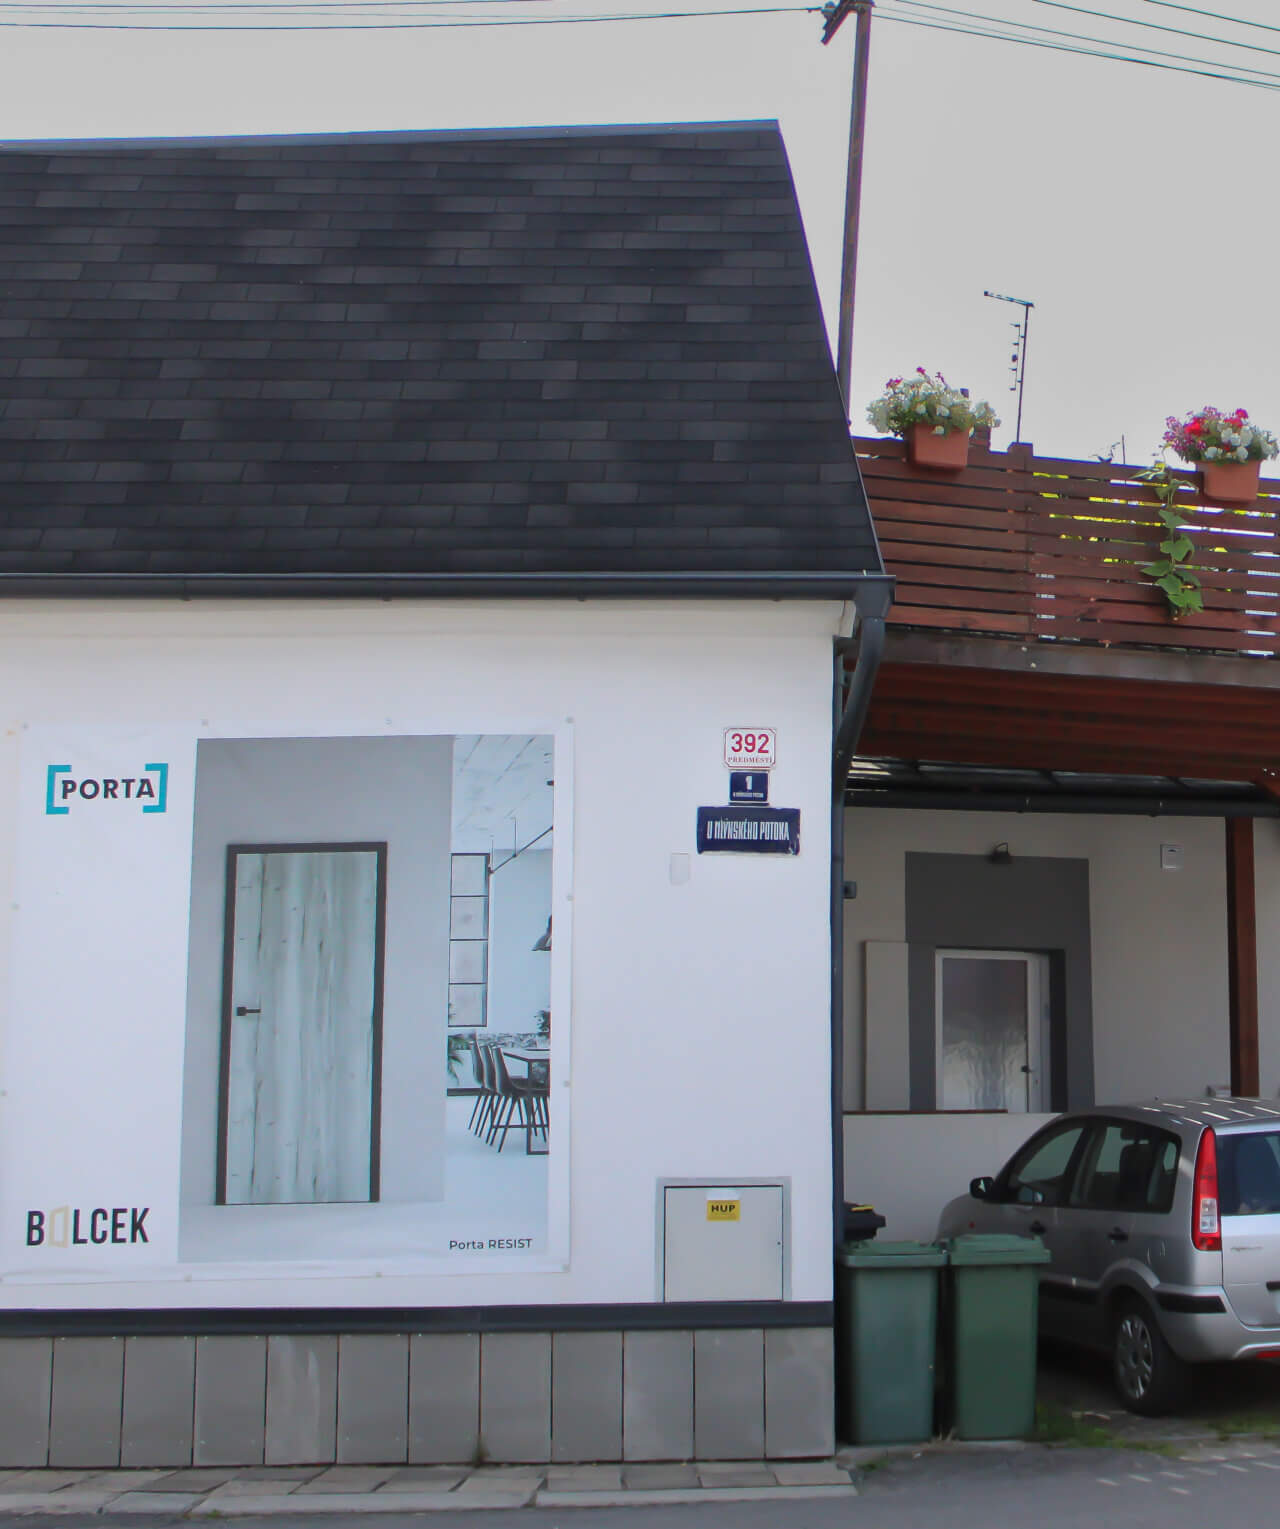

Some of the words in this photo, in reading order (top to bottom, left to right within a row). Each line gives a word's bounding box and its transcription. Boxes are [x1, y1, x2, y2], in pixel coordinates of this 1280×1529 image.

[731, 733, 770, 753] 392
[61, 778, 155, 799] PORTA
[745, 776, 752, 790] 1
[706, 821, 713, 839] U
[759, 821, 790, 840] POTOKA
[711, 1204, 736, 1213] HUP
[449, 1240, 484, 1250] Porta
[488, 1238, 533, 1249] RESIST
